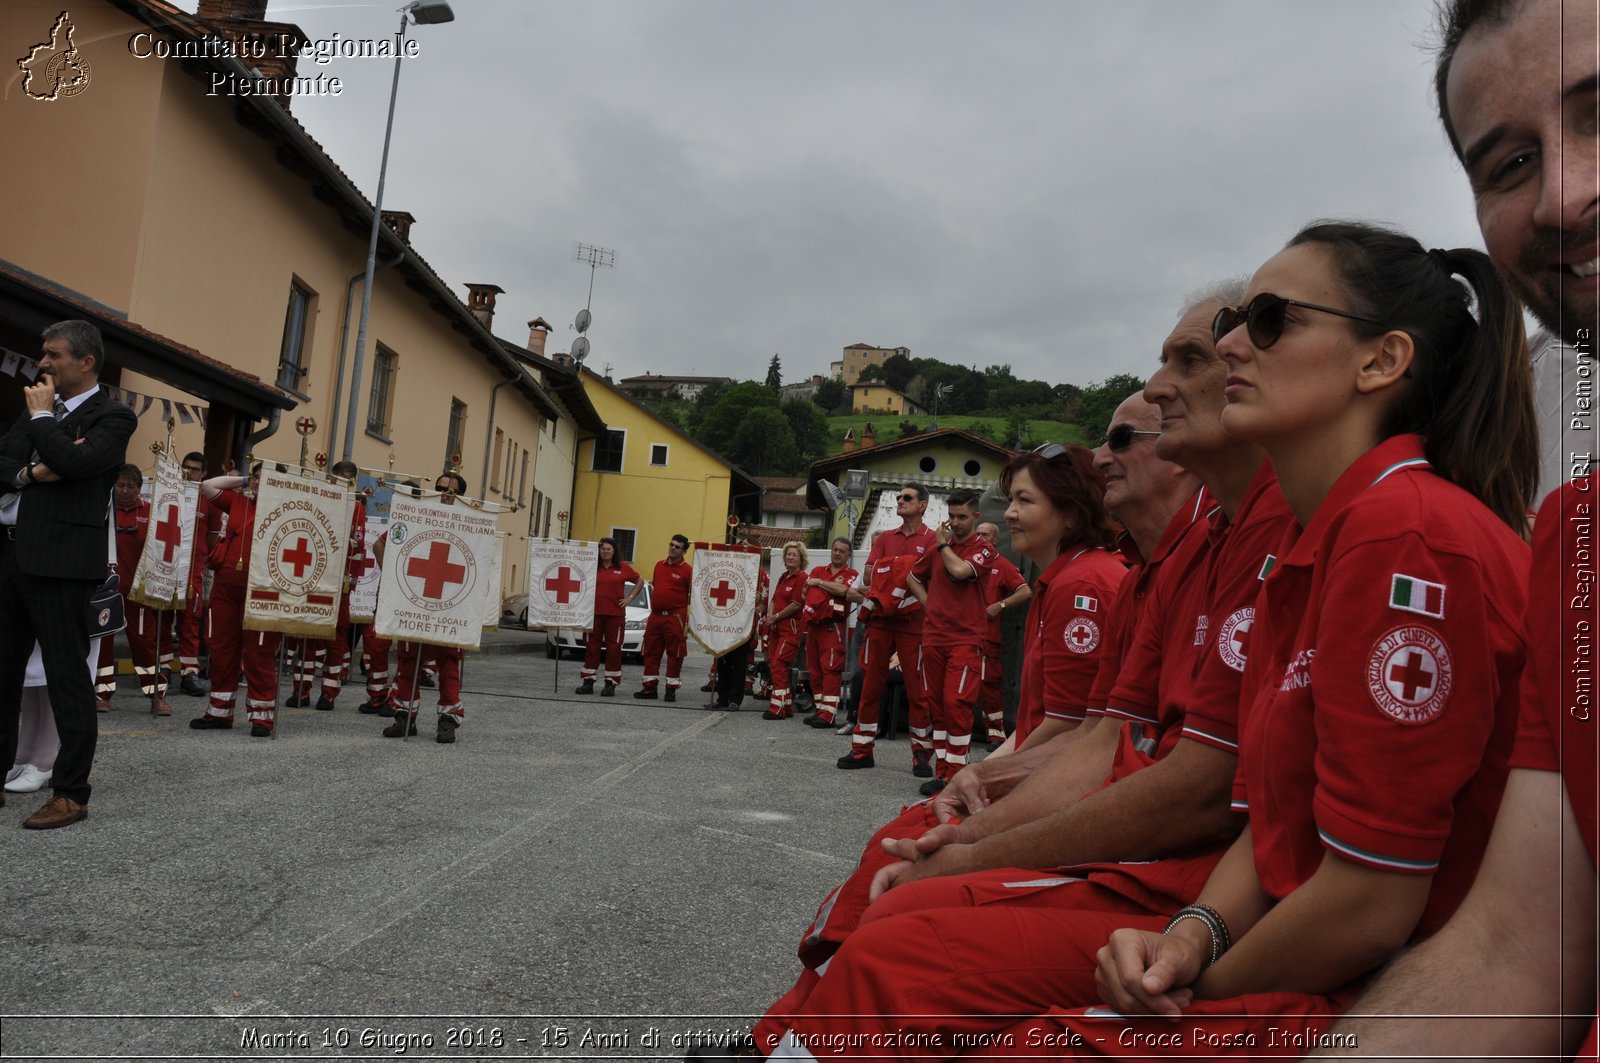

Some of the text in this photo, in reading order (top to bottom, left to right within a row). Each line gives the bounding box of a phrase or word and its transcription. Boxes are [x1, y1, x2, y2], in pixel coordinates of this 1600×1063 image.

[257, 500, 340, 553] CROCE ROSSA ITALIANA
[391, 511, 495, 536] CROCE ROSSA ITALIANA
[396, 503, 493, 527] CORPO VOLONTARI DEL SOCCORSO
[401, 531, 446, 556] CONVENZIONE
[447, 533, 456, 542] DI
[455, 537, 475, 567] GINEVRA
[694, 560, 755, 592] CROCE ROSSA ITALIANA
[249, 601, 291, 613] COMITATO
[394, 609, 430, 622] COMITATO
[437, 616, 468, 627] LOCALE
[539, 610, 577, 618] DELEGAZIONE
[398, 619, 457, 636] MORETTA
[541, 616, 582, 624] PEVERAGNO
[696, 623, 743, 634] SAVIGLIANO
[1220, 612, 1244, 665] CONVENZIONE DI
[1386, 634, 1399, 648] DI
[1399, 629, 1441, 655] GINEVRA
[1438, 655, 1449, 667] 22
[1369, 645, 1404, 717] CONVENZIONE
[1431, 668, 1451, 709] AGOSTO
